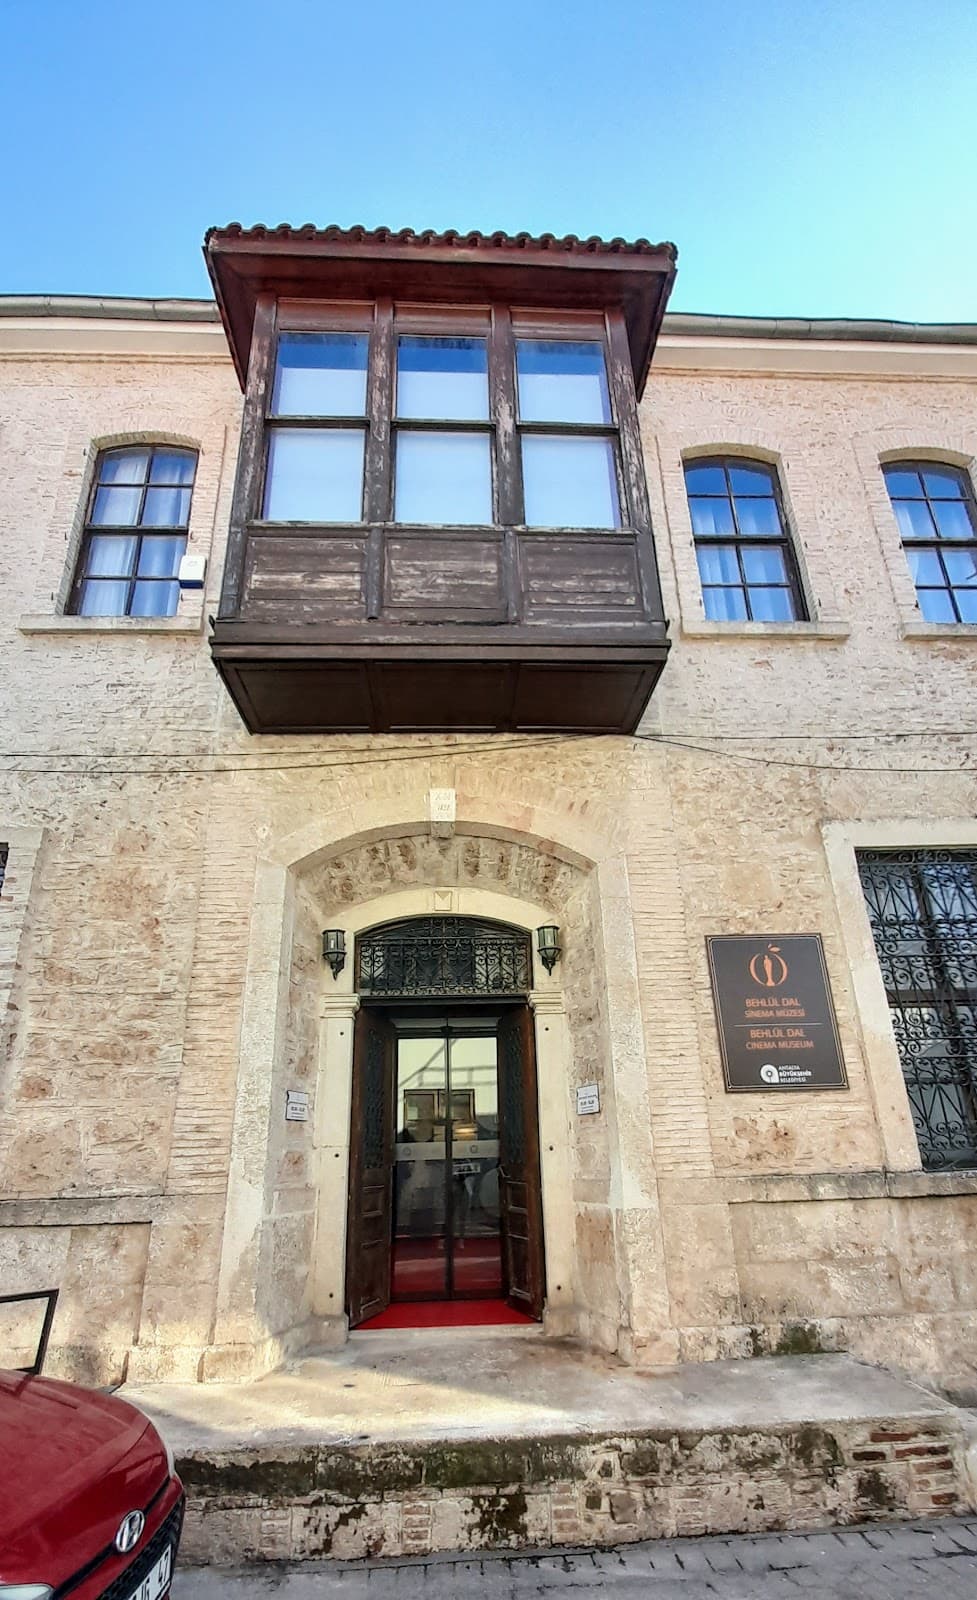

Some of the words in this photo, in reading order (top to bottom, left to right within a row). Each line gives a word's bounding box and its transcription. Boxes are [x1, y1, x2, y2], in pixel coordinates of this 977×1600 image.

[745, 997, 781, 1007] BEHLÜL
[782, 998, 801, 1006] DAL
[750, 1027, 785, 1038] BEHLÜL
[787, 1028, 806, 1037] DAL
[746, 1041, 777, 1050] CINEMA
[778, 1040, 814, 1049] MUSEUM
